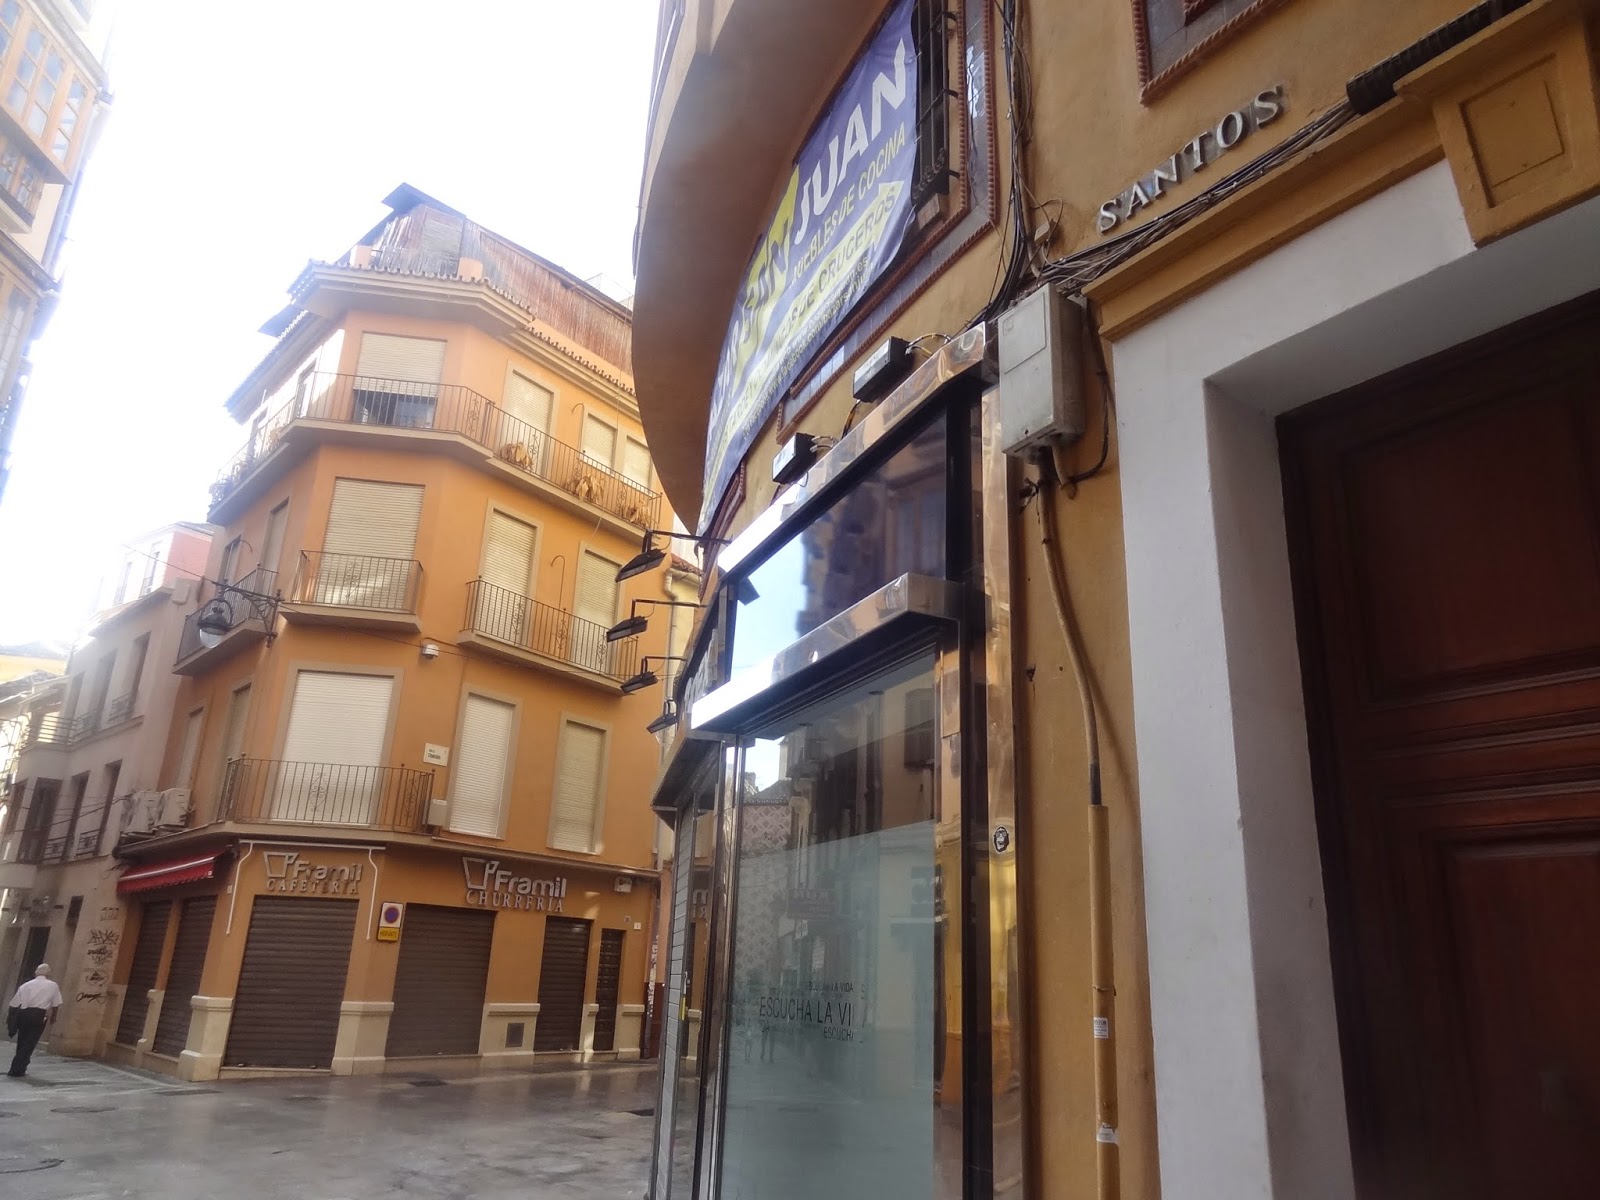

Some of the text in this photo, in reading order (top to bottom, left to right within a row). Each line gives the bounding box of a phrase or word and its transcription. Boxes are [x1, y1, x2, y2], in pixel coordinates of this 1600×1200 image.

[794, 37, 906, 245] JUAN
[838, 184, 856, 226] DE
[857, 120, 906, 199] COCINA
[1100, 86, 1282, 234] SANTOS
[818, 185, 898, 293] CRUCEROS
[266, 878, 359, 895] CAFETERIA
[293, 860, 362, 881] Framil
[494, 869, 567, 898] Framil
[759, 996, 813, 1022] ESCUCHA
[817, 1000, 833, 1024] LA
